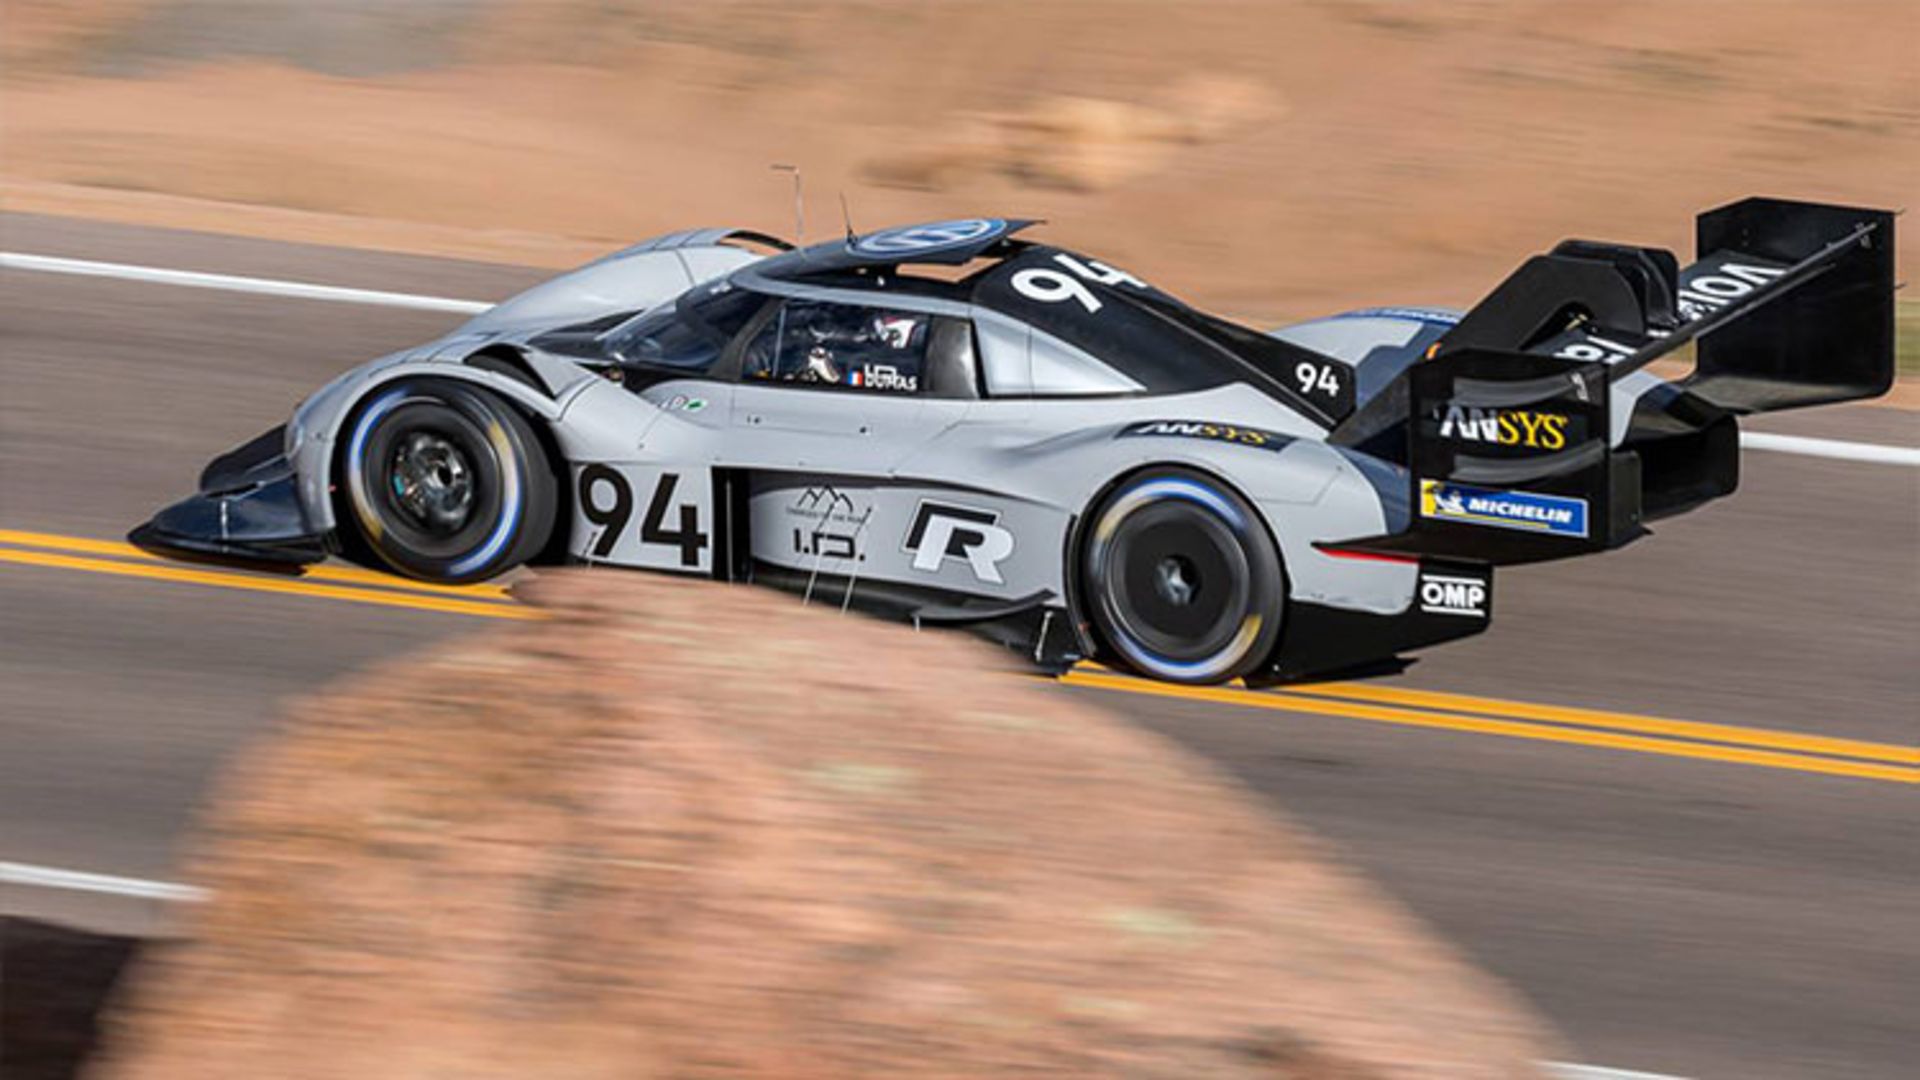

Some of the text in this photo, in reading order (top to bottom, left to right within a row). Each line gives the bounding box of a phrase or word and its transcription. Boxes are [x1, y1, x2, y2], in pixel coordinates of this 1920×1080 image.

[1010, 253, 1148, 313] 94
[1296, 362, 1340, 397] 94
[1440, 406, 1568, 450] ANSYS
[578, 462, 708, 567] 94
[1468, 498, 1573, 523] MICHELIN
[901, 499, 1014, 584] R
[1421, 582, 1485, 608] OMP
